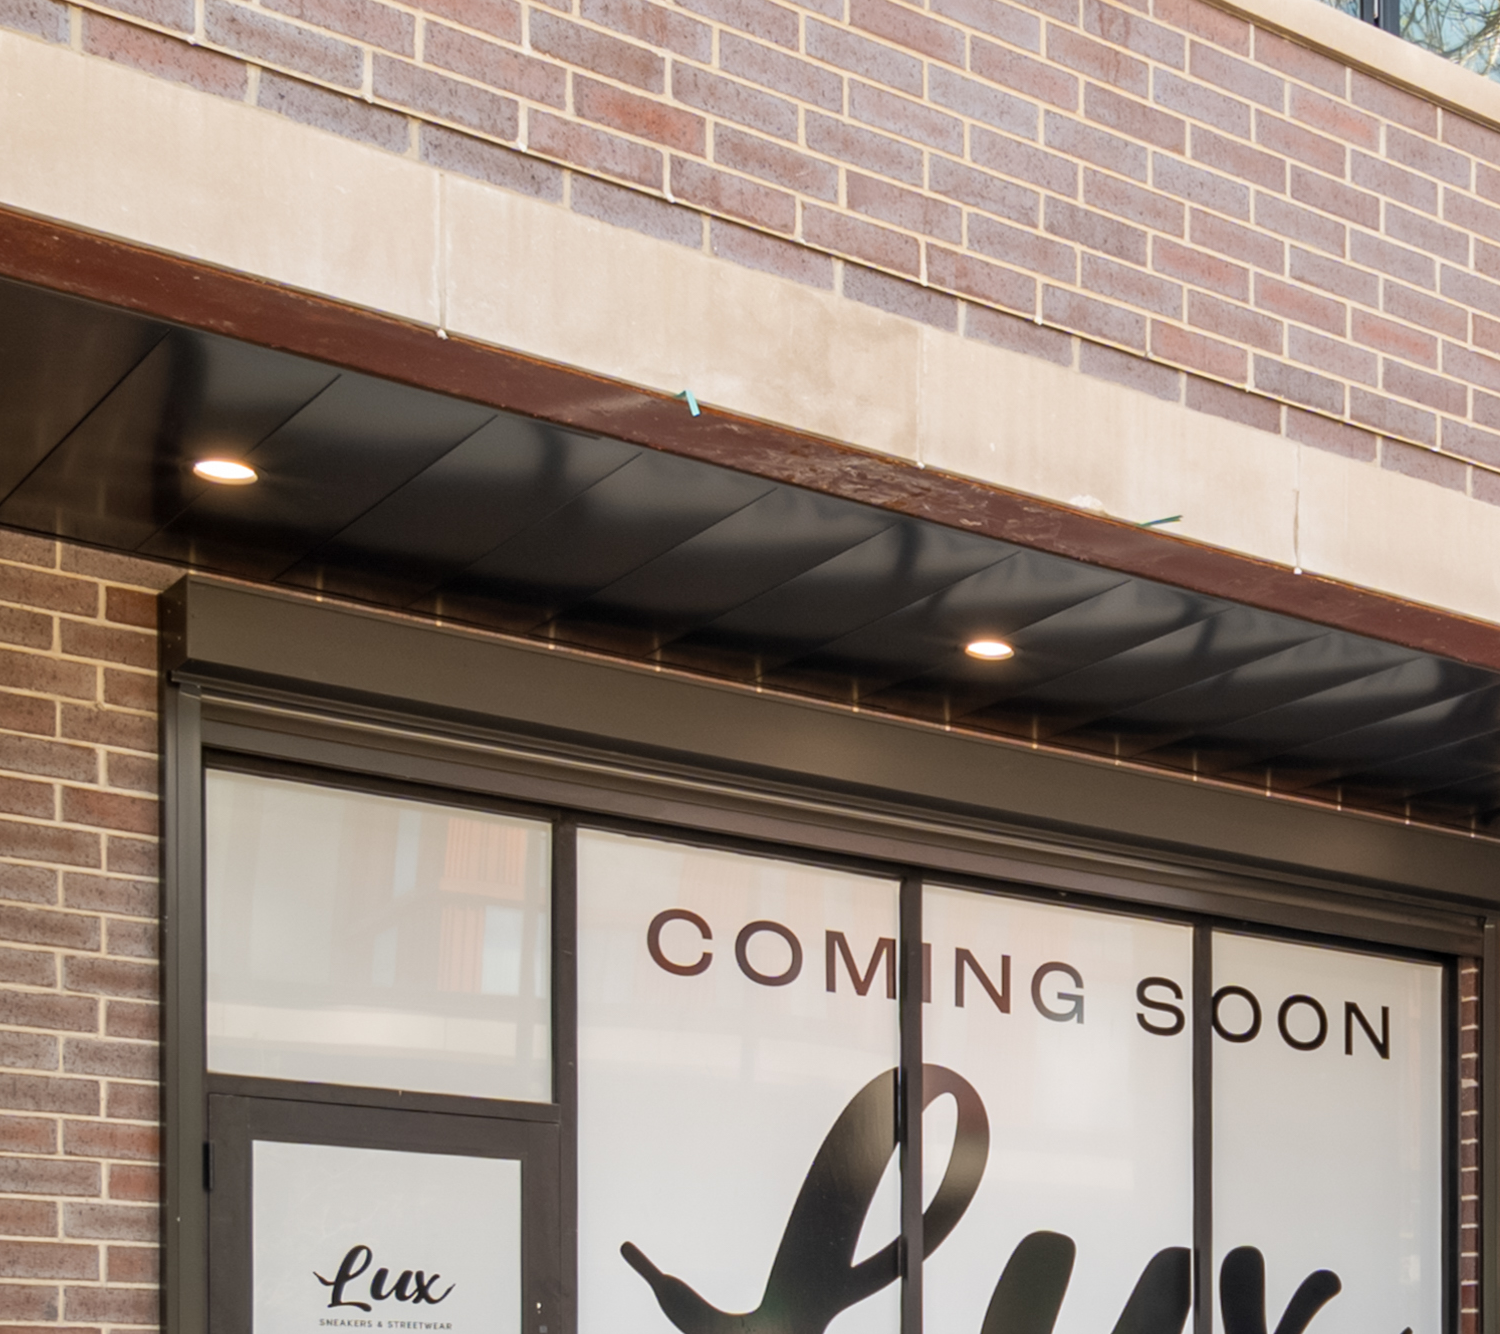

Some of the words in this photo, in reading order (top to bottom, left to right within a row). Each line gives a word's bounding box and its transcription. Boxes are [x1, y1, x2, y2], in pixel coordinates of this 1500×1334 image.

[646, 907, 1088, 1025] COMING
[1135, 975, 1392, 1060] SOON
[312, 1244, 456, 1312] Lux
[319, 1318, 373, 1328] SNEAKERS
[388, 1320, 452, 1330] STREETWEAR
